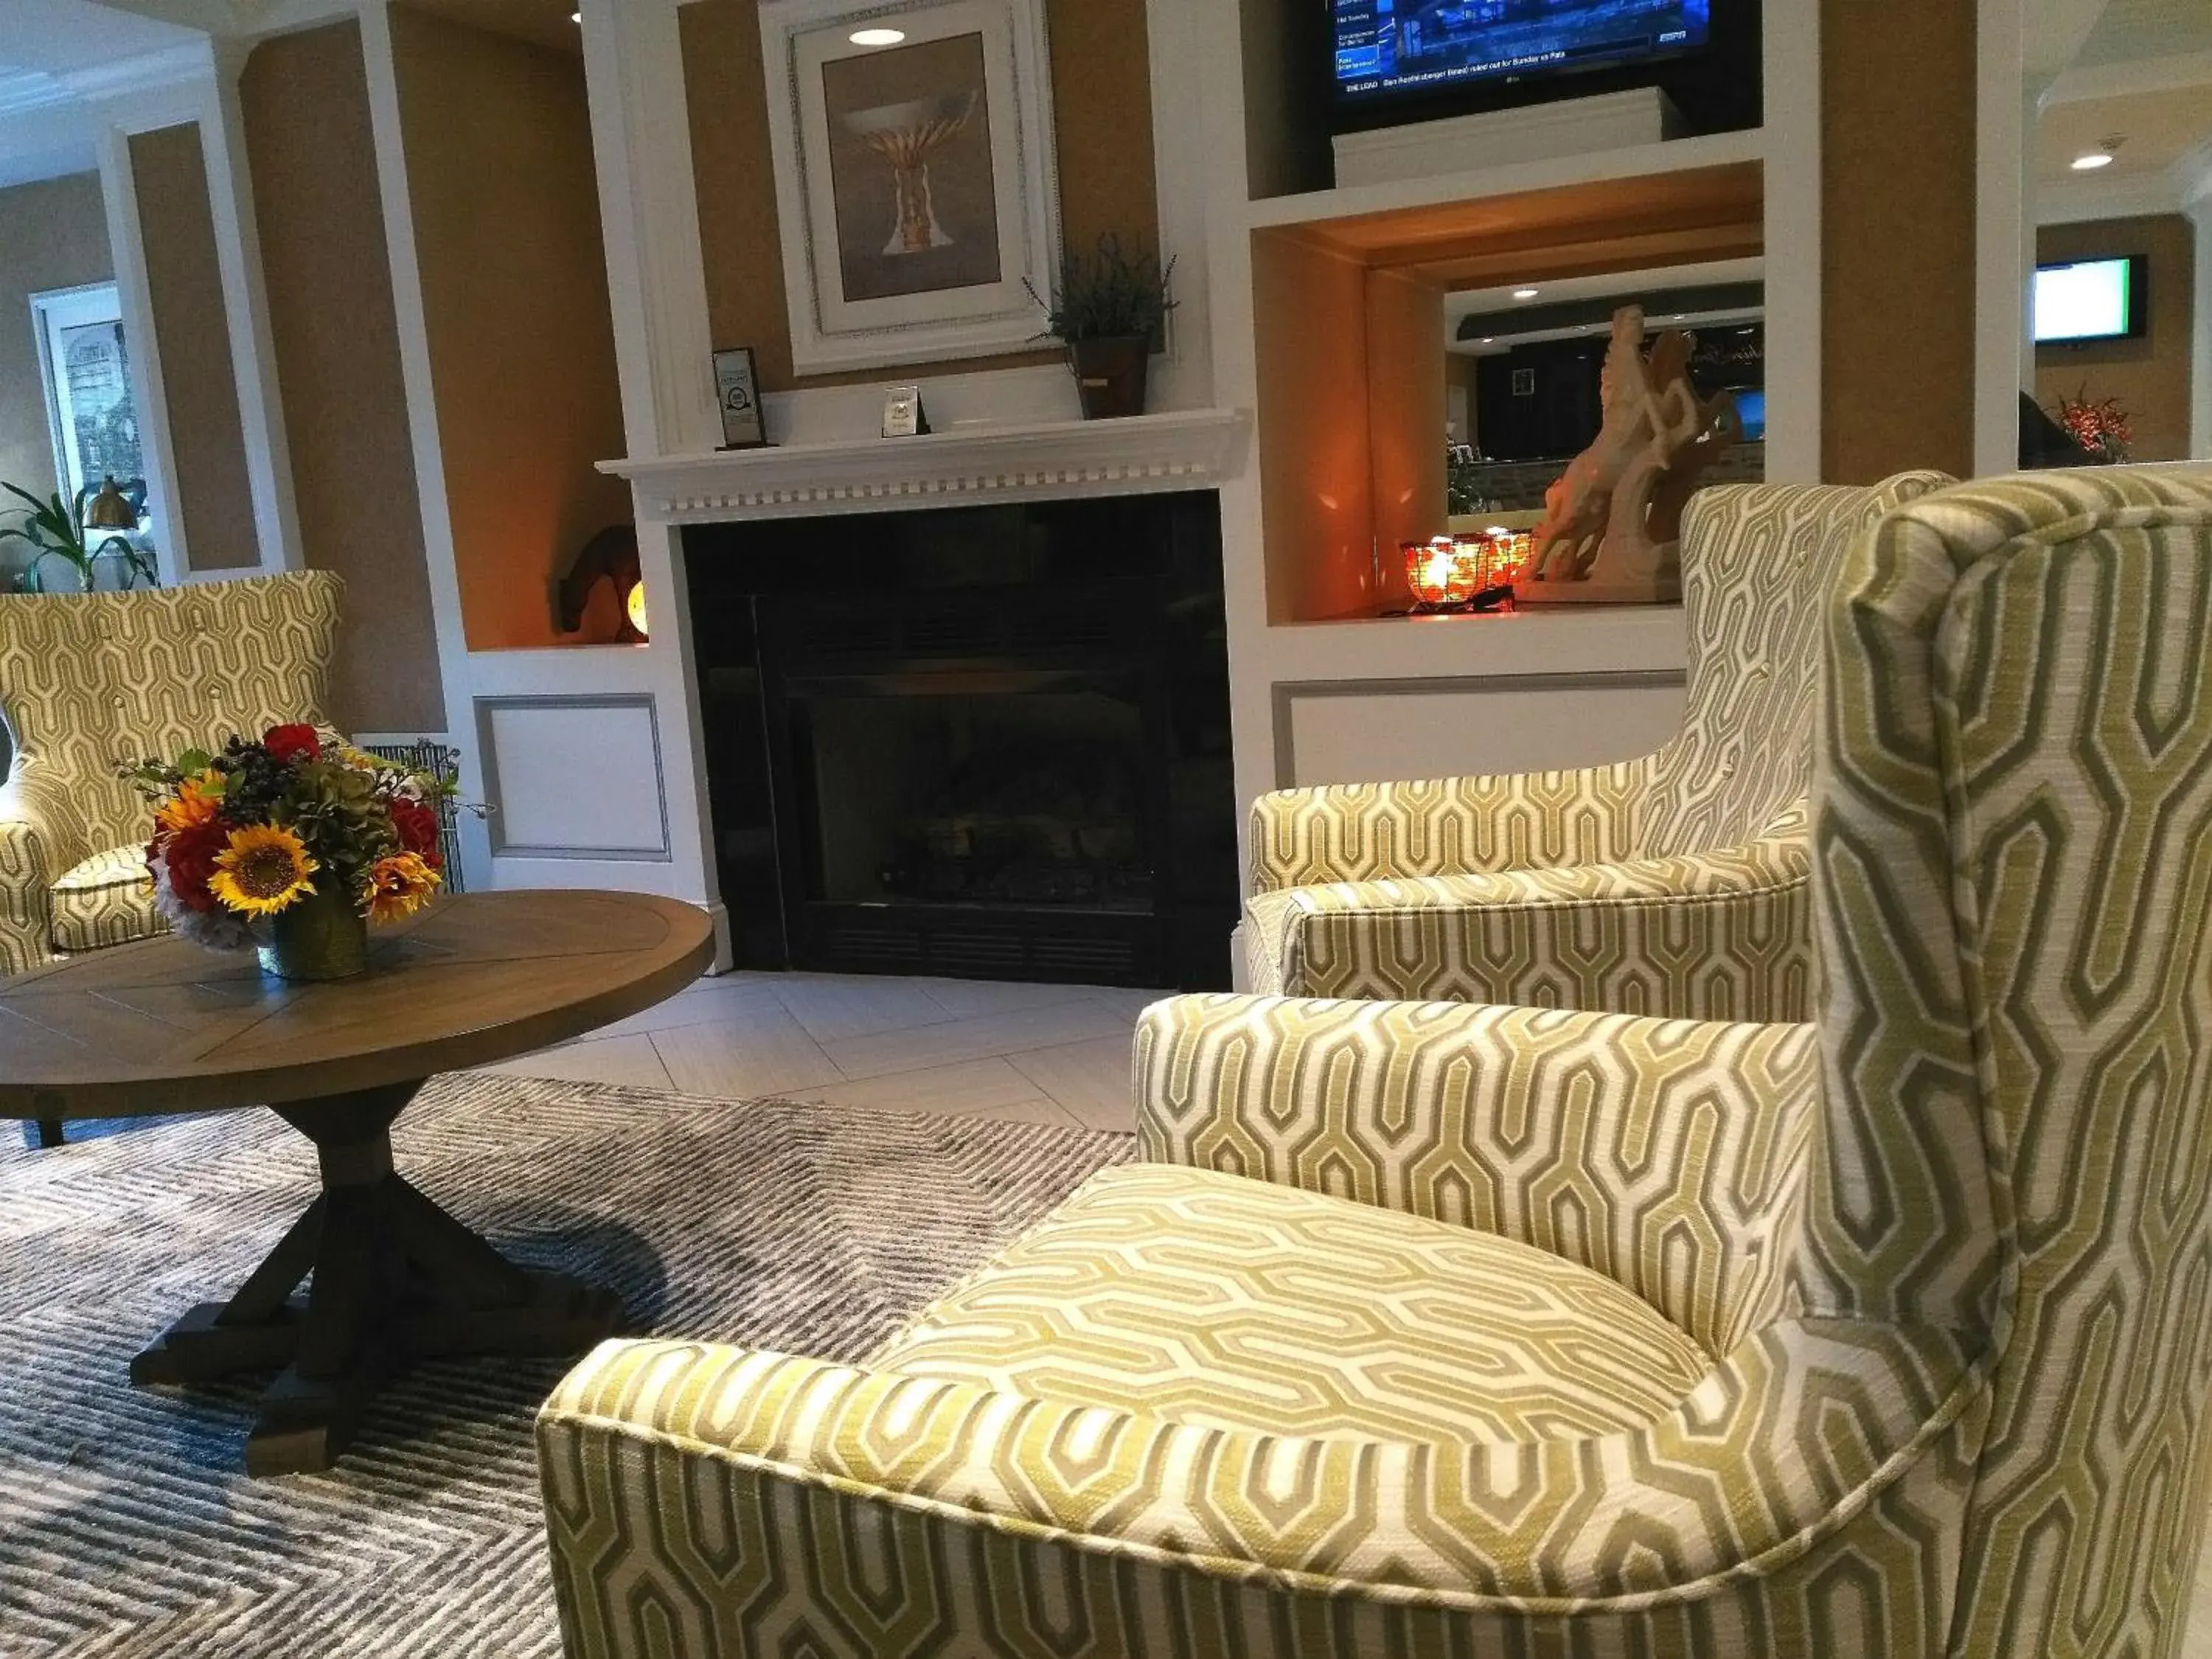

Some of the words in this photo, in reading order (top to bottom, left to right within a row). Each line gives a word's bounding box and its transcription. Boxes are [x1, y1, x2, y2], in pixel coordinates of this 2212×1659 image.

[1659, 30, 1686, 42] ESPN
[1470, 63, 1488, 72] ruled
[1489, 61, 1500, 69] out
[1501, 60, 1512, 68] for
[1512, 55, 1540, 66] Sunday
[1360, 81, 1378, 91] LEAD
